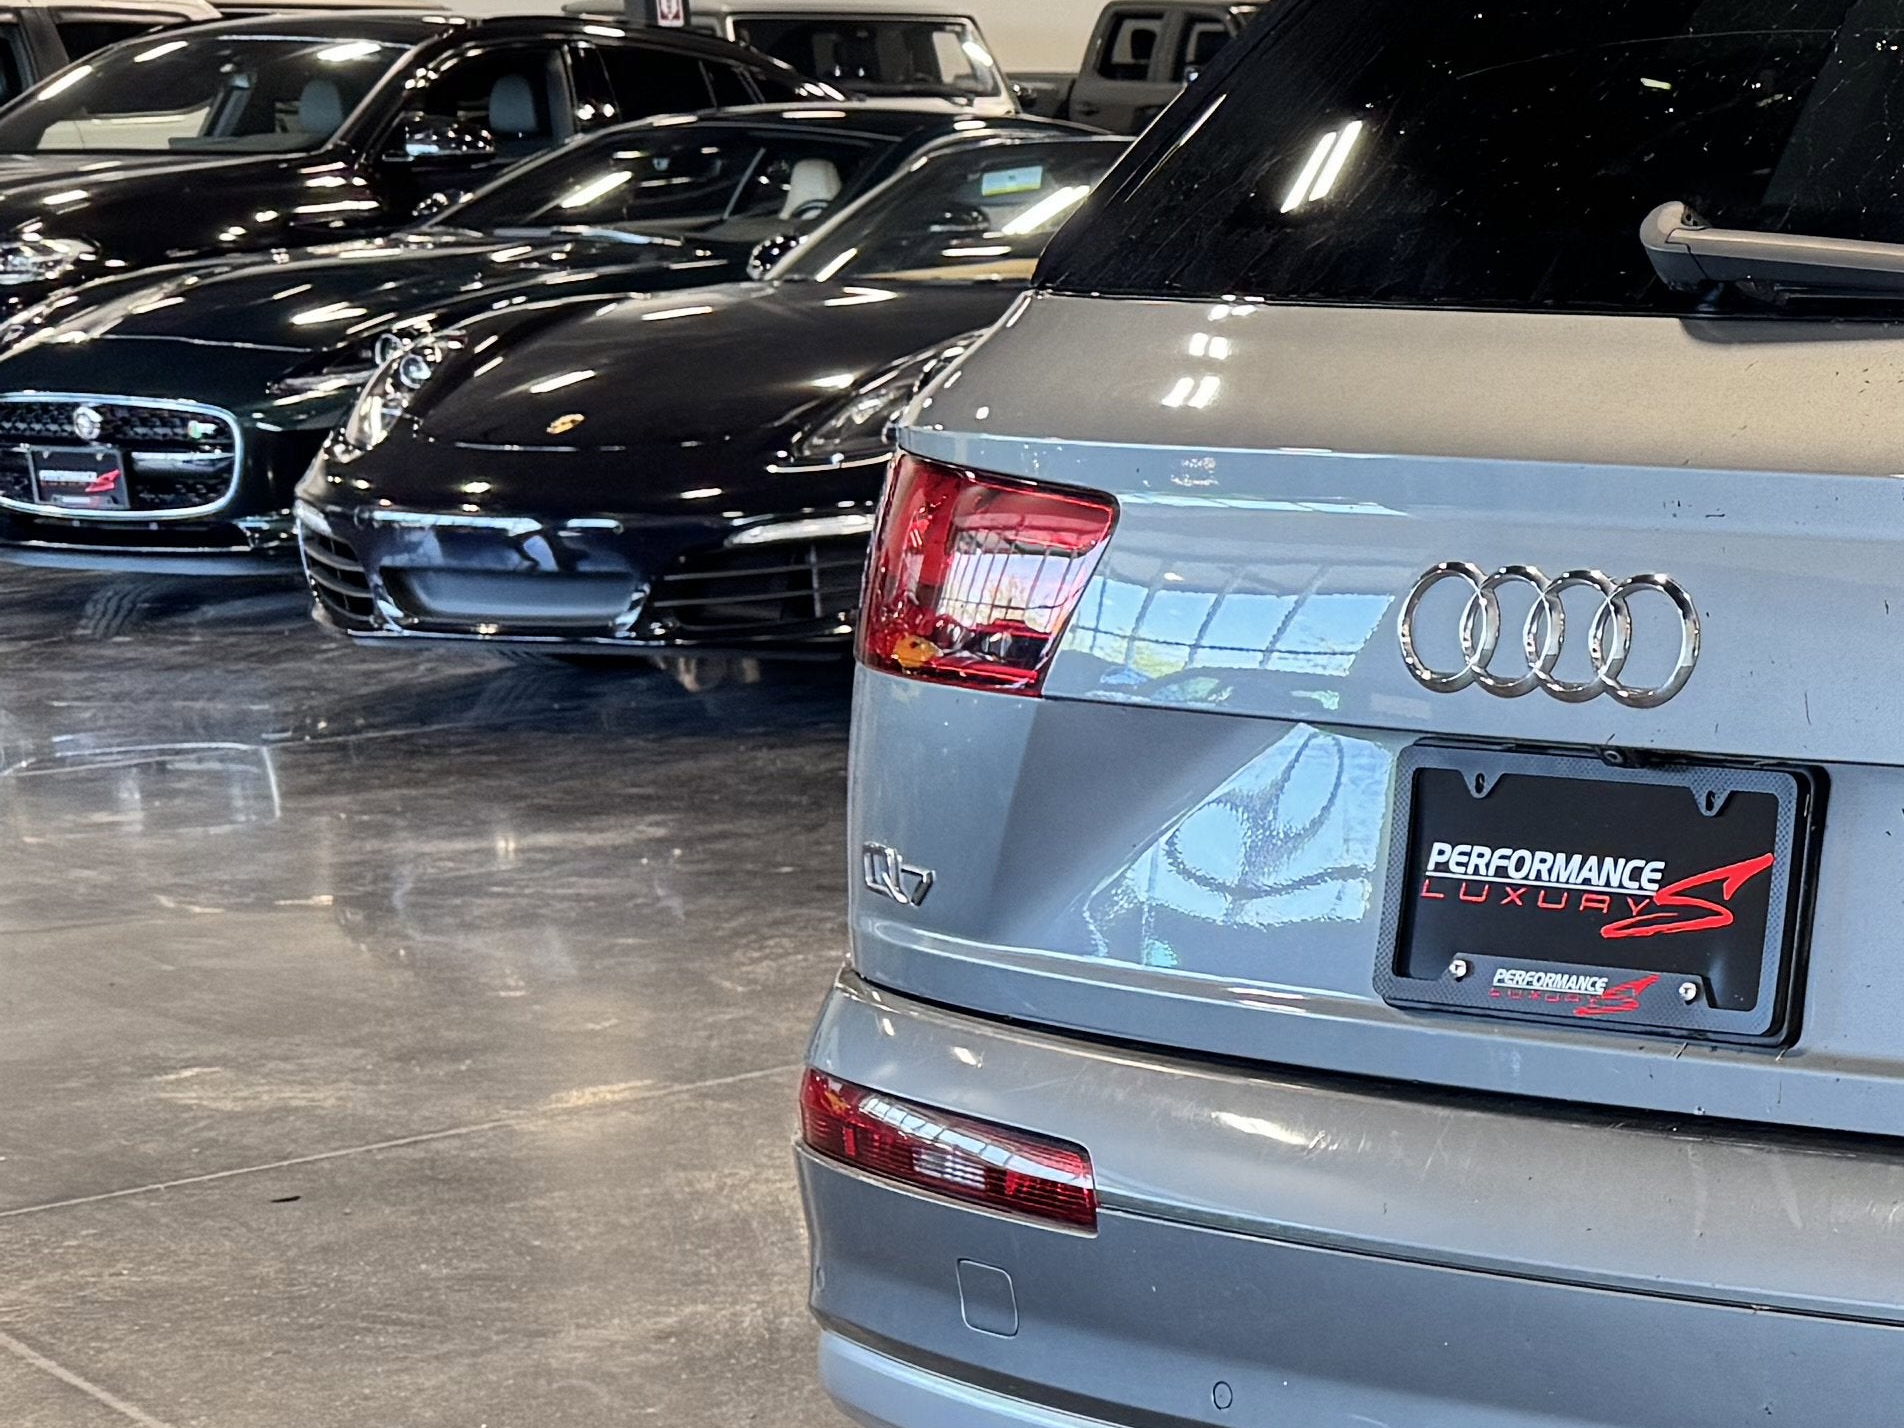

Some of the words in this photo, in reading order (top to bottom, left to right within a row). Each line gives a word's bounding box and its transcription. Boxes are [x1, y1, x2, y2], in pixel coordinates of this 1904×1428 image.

[862, 841, 936, 909] Q7
[1426, 842, 1665, 891] PERFORMANCE
[1420, 879, 1656, 915] LUXURY
[1493, 969, 1608, 993] PERFORMANCE
